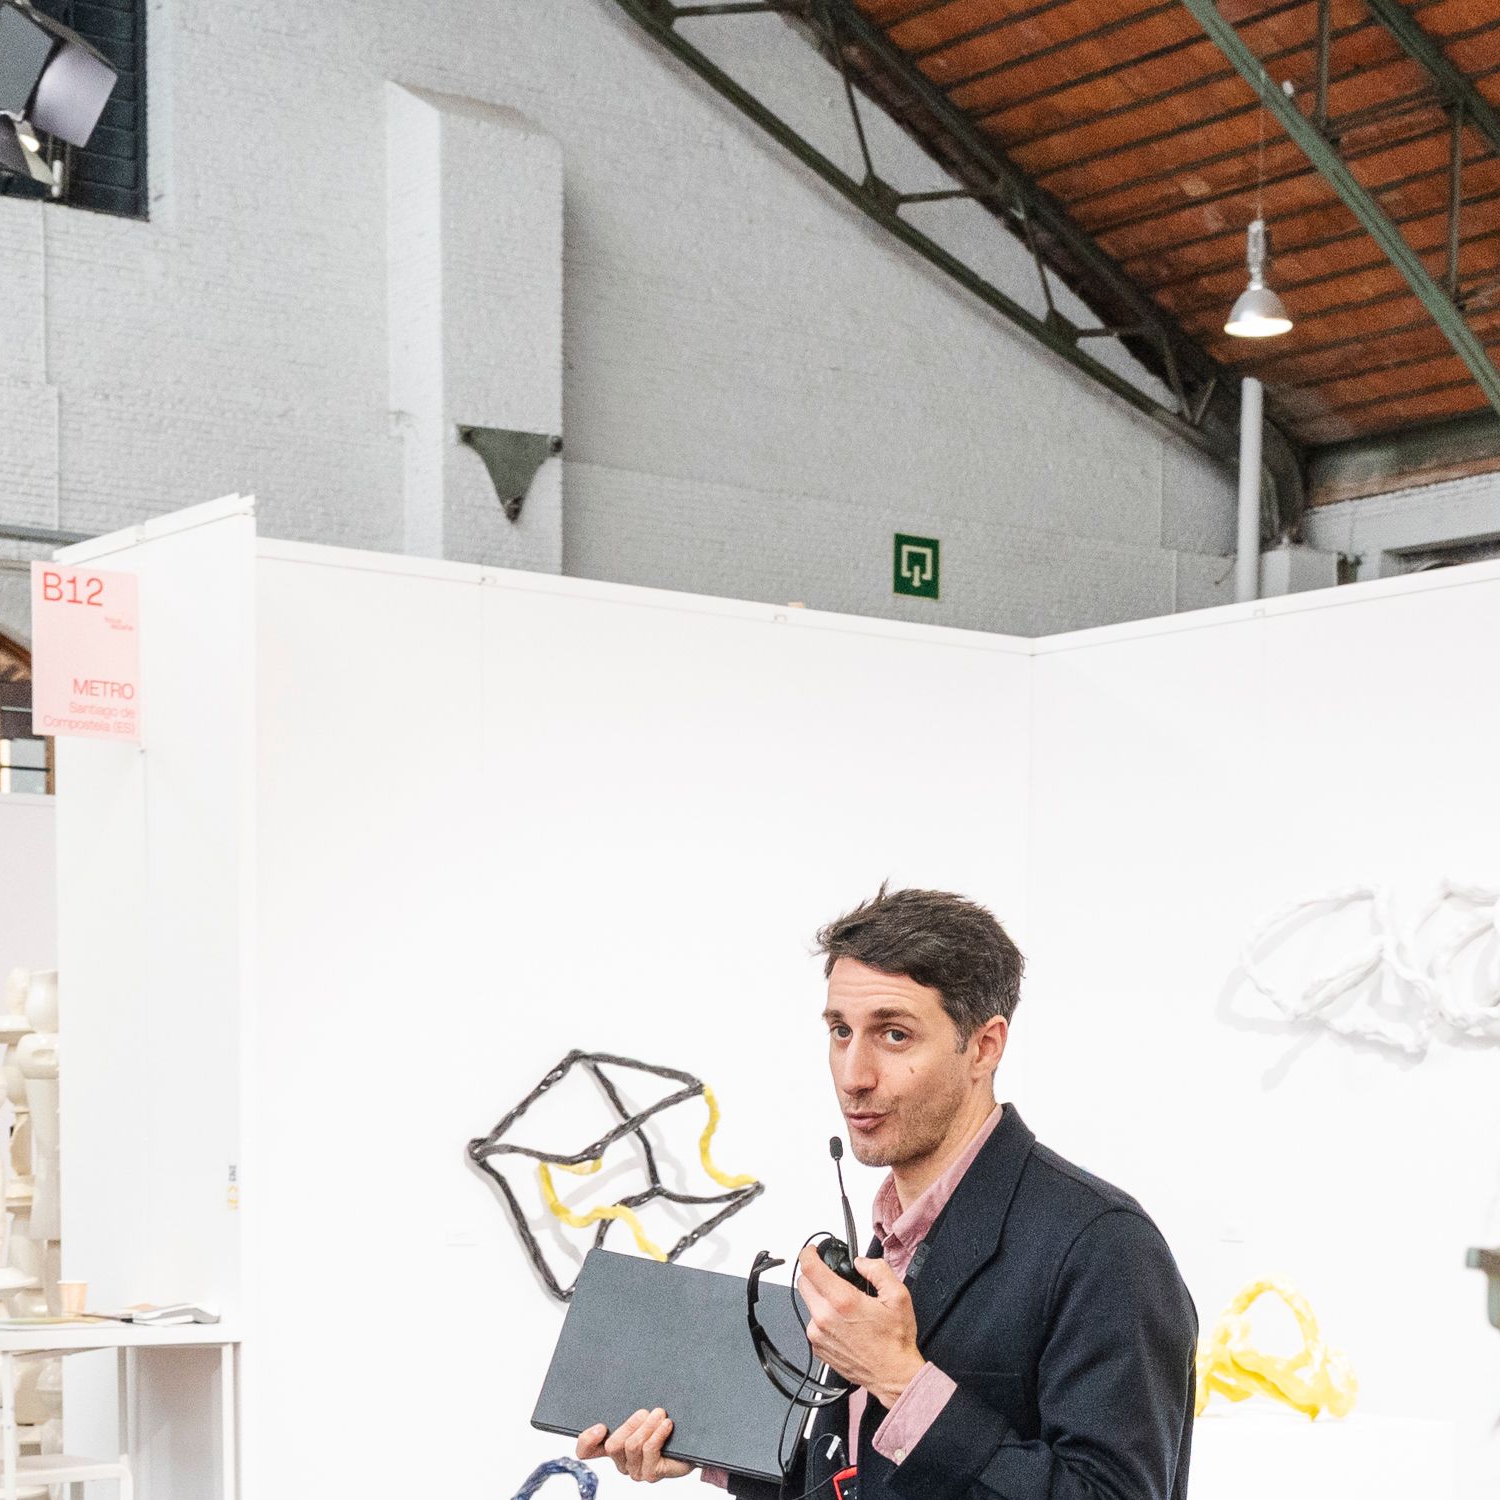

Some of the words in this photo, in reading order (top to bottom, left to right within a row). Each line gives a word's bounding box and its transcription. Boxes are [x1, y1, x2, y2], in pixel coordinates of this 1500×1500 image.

[43, 571, 104, 607] B12
[73, 678, 135, 700] METRO
[69, 701, 118, 719] Santiago
[120, 707, 135, 719] de
[43, 714, 110, 732] Compostela
[113, 720, 135, 736] (ES)
